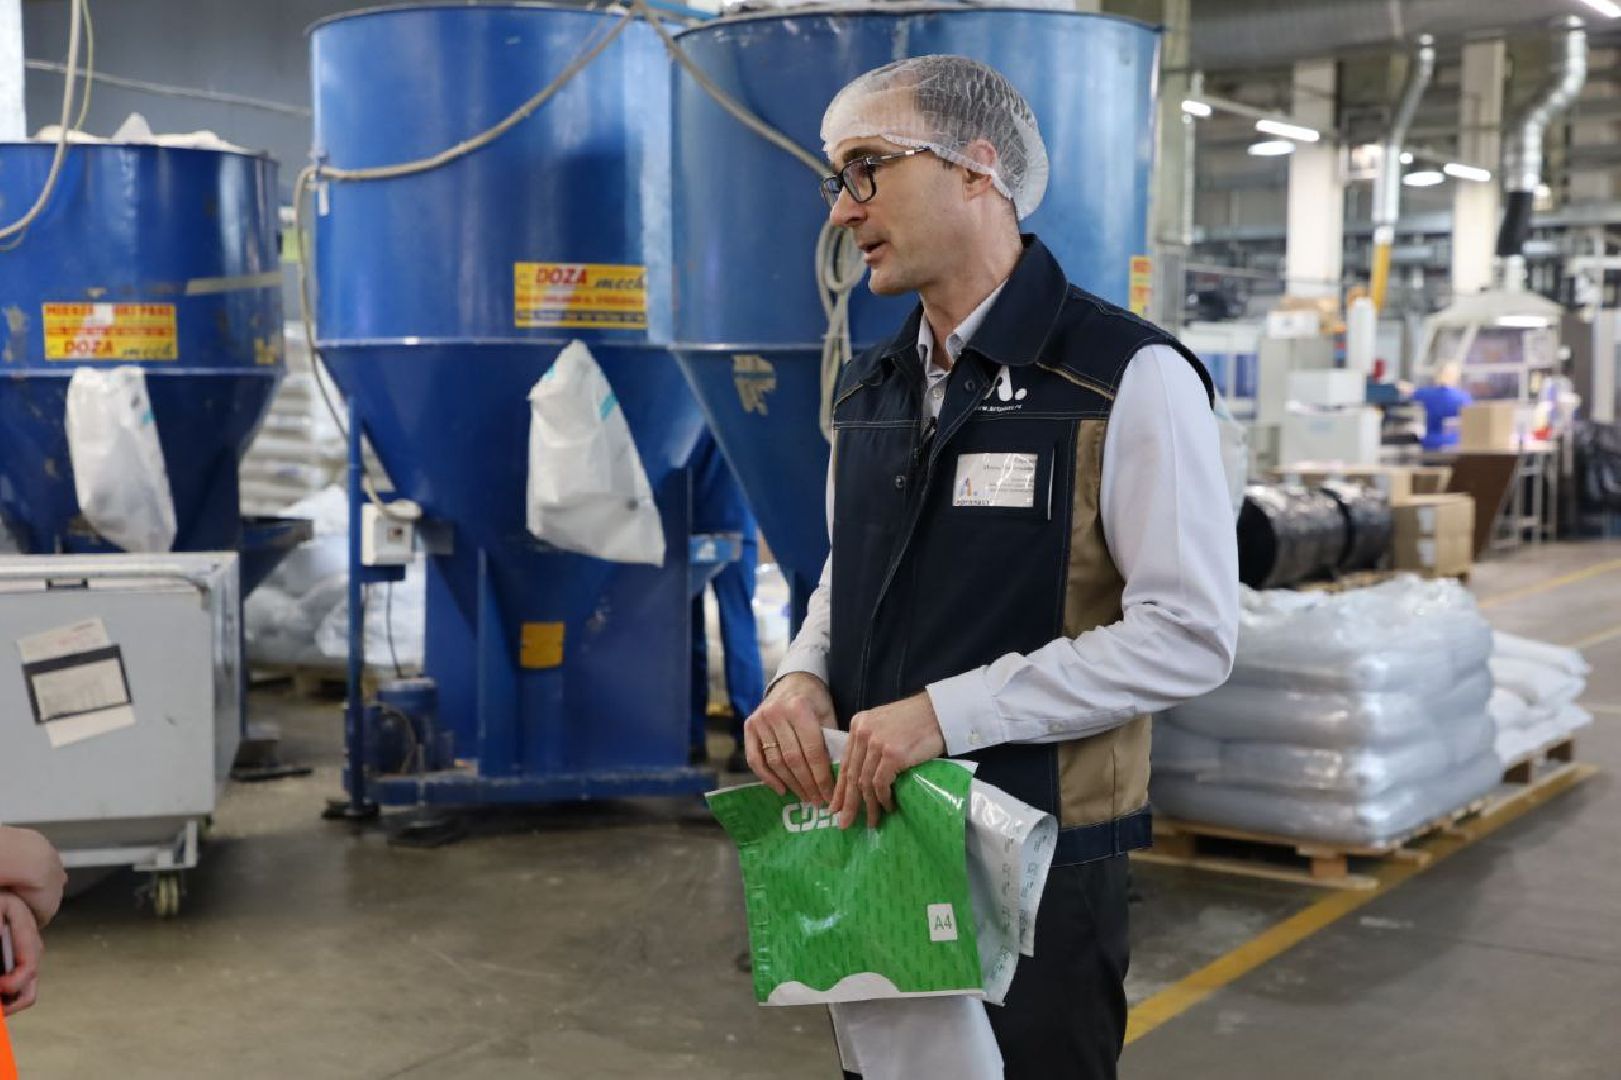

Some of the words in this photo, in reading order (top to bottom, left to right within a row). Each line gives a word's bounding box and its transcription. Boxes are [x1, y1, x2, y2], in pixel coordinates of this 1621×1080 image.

[536, 267, 587, 283] DOZA
[64, 340, 113, 354] DOZA
[934, 914, 952, 930] A4
